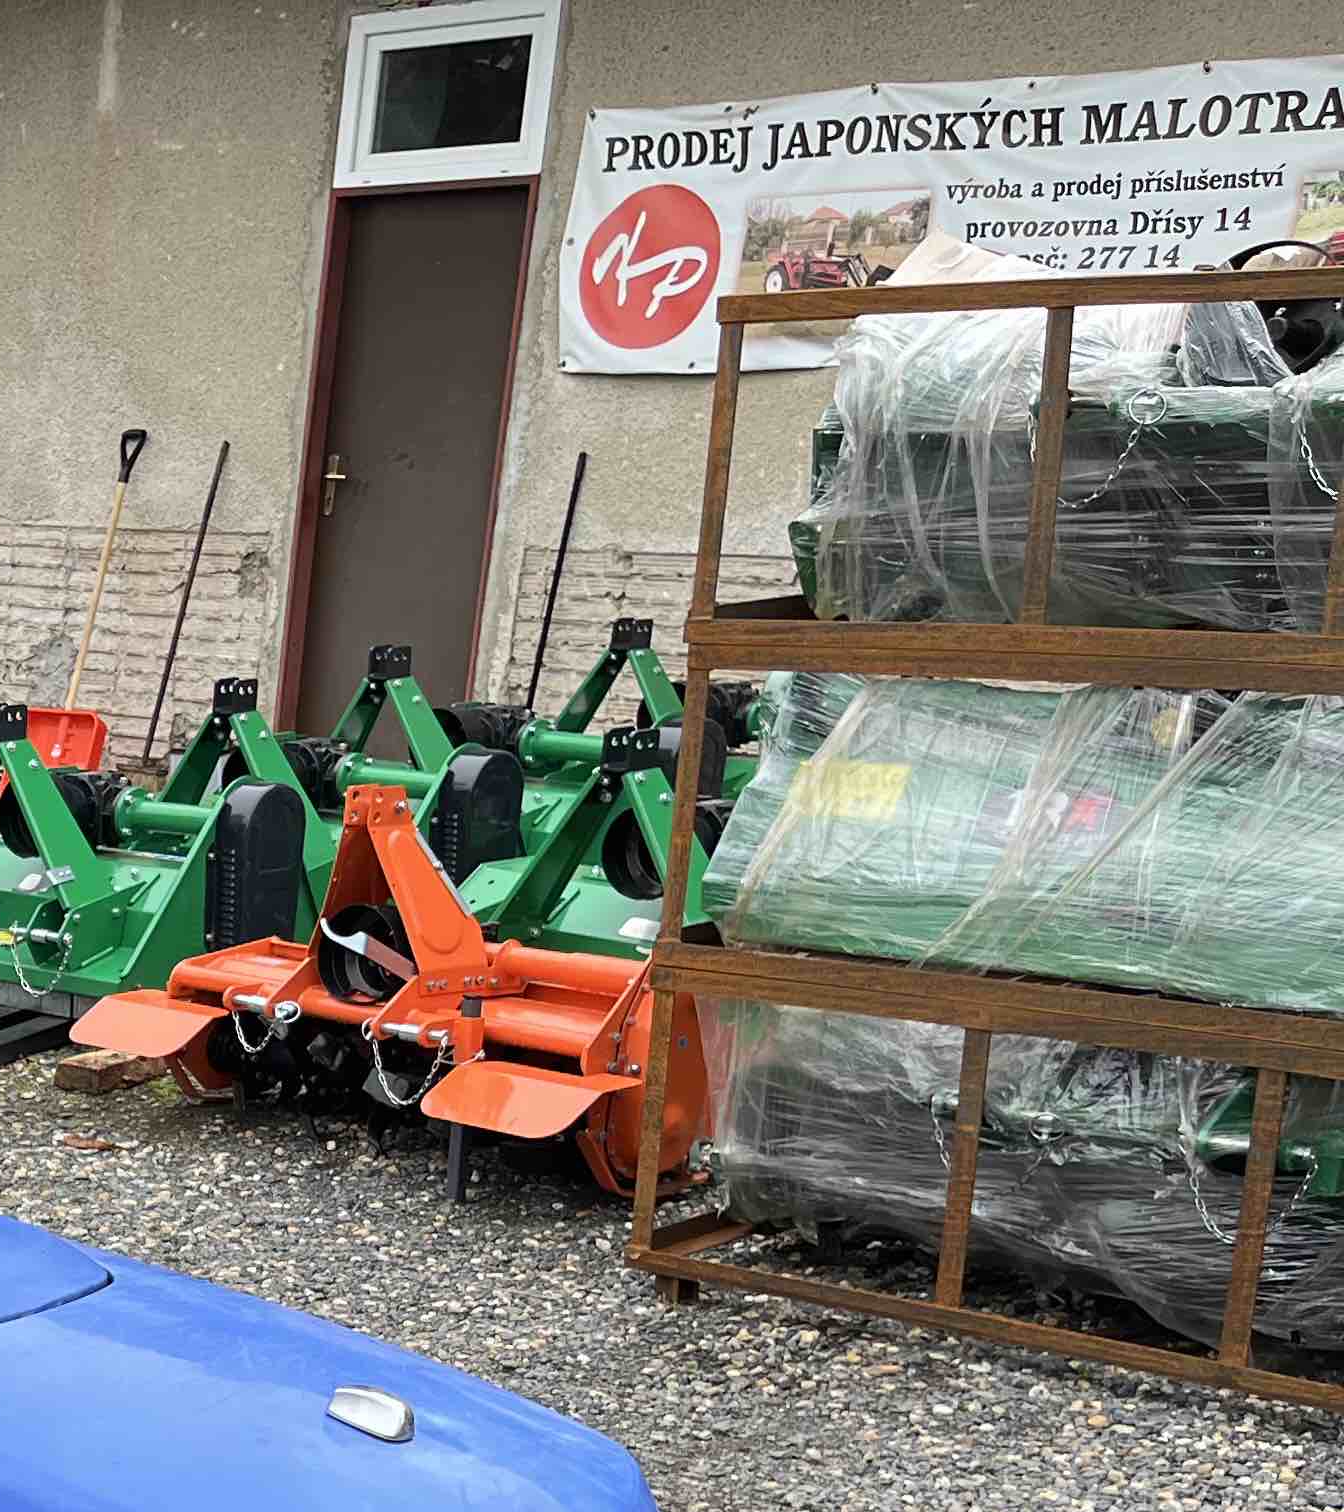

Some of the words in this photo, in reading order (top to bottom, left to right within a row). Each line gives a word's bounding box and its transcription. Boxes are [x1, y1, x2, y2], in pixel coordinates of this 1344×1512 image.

[602, 126, 754, 173] PRODEJ
[762, 97, 1065, 170] JAPONSKÝCH
[1079, 86, 1344, 146] MALOTRA
[946, 177, 1023, 204] výroba
[1031, 182, 1044, 198] a
[1052, 172, 1122, 201] prodej
[1129, 163, 1288, 199] příslušenství
[965, 216, 1119, 243] provozovna
[1128, 208, 1204, 239] Dřísy
[1214, 206, 1253, 232] 14
[1016, 245, 1068, 270] sč:
[1076, 245, 1138, 271] 277
[1146, 244, 1181, 269] 14
